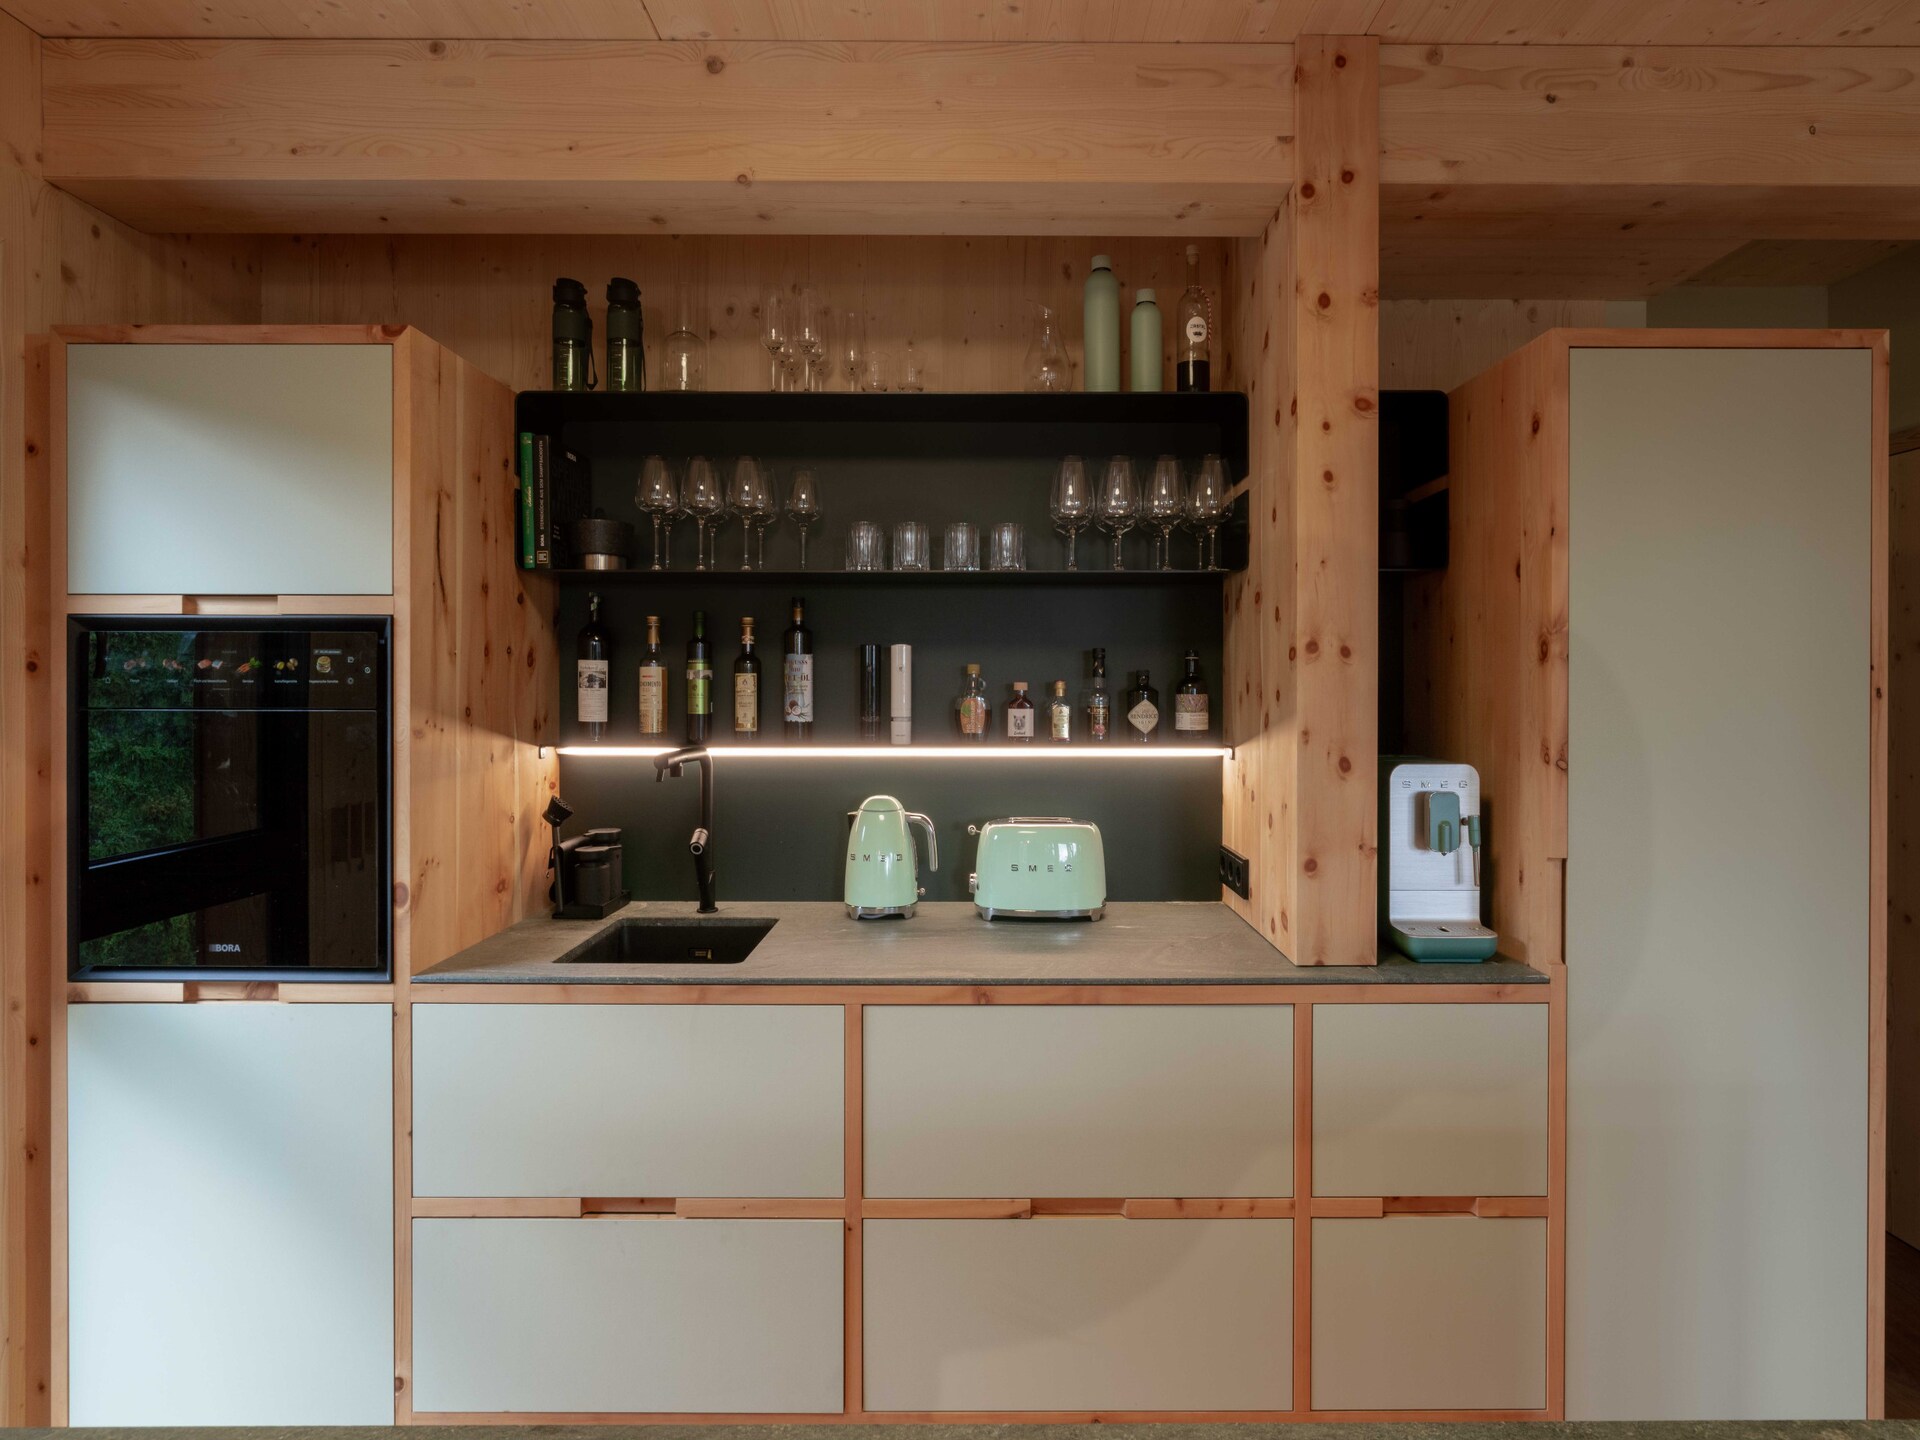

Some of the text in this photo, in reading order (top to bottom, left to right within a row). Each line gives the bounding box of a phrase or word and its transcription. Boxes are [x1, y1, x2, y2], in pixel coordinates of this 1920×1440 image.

[1402, 780, 1468, 789] SMEG
[1010, 863, 1073, 872] SMEG
[216, 944, 241, 953] BORA
